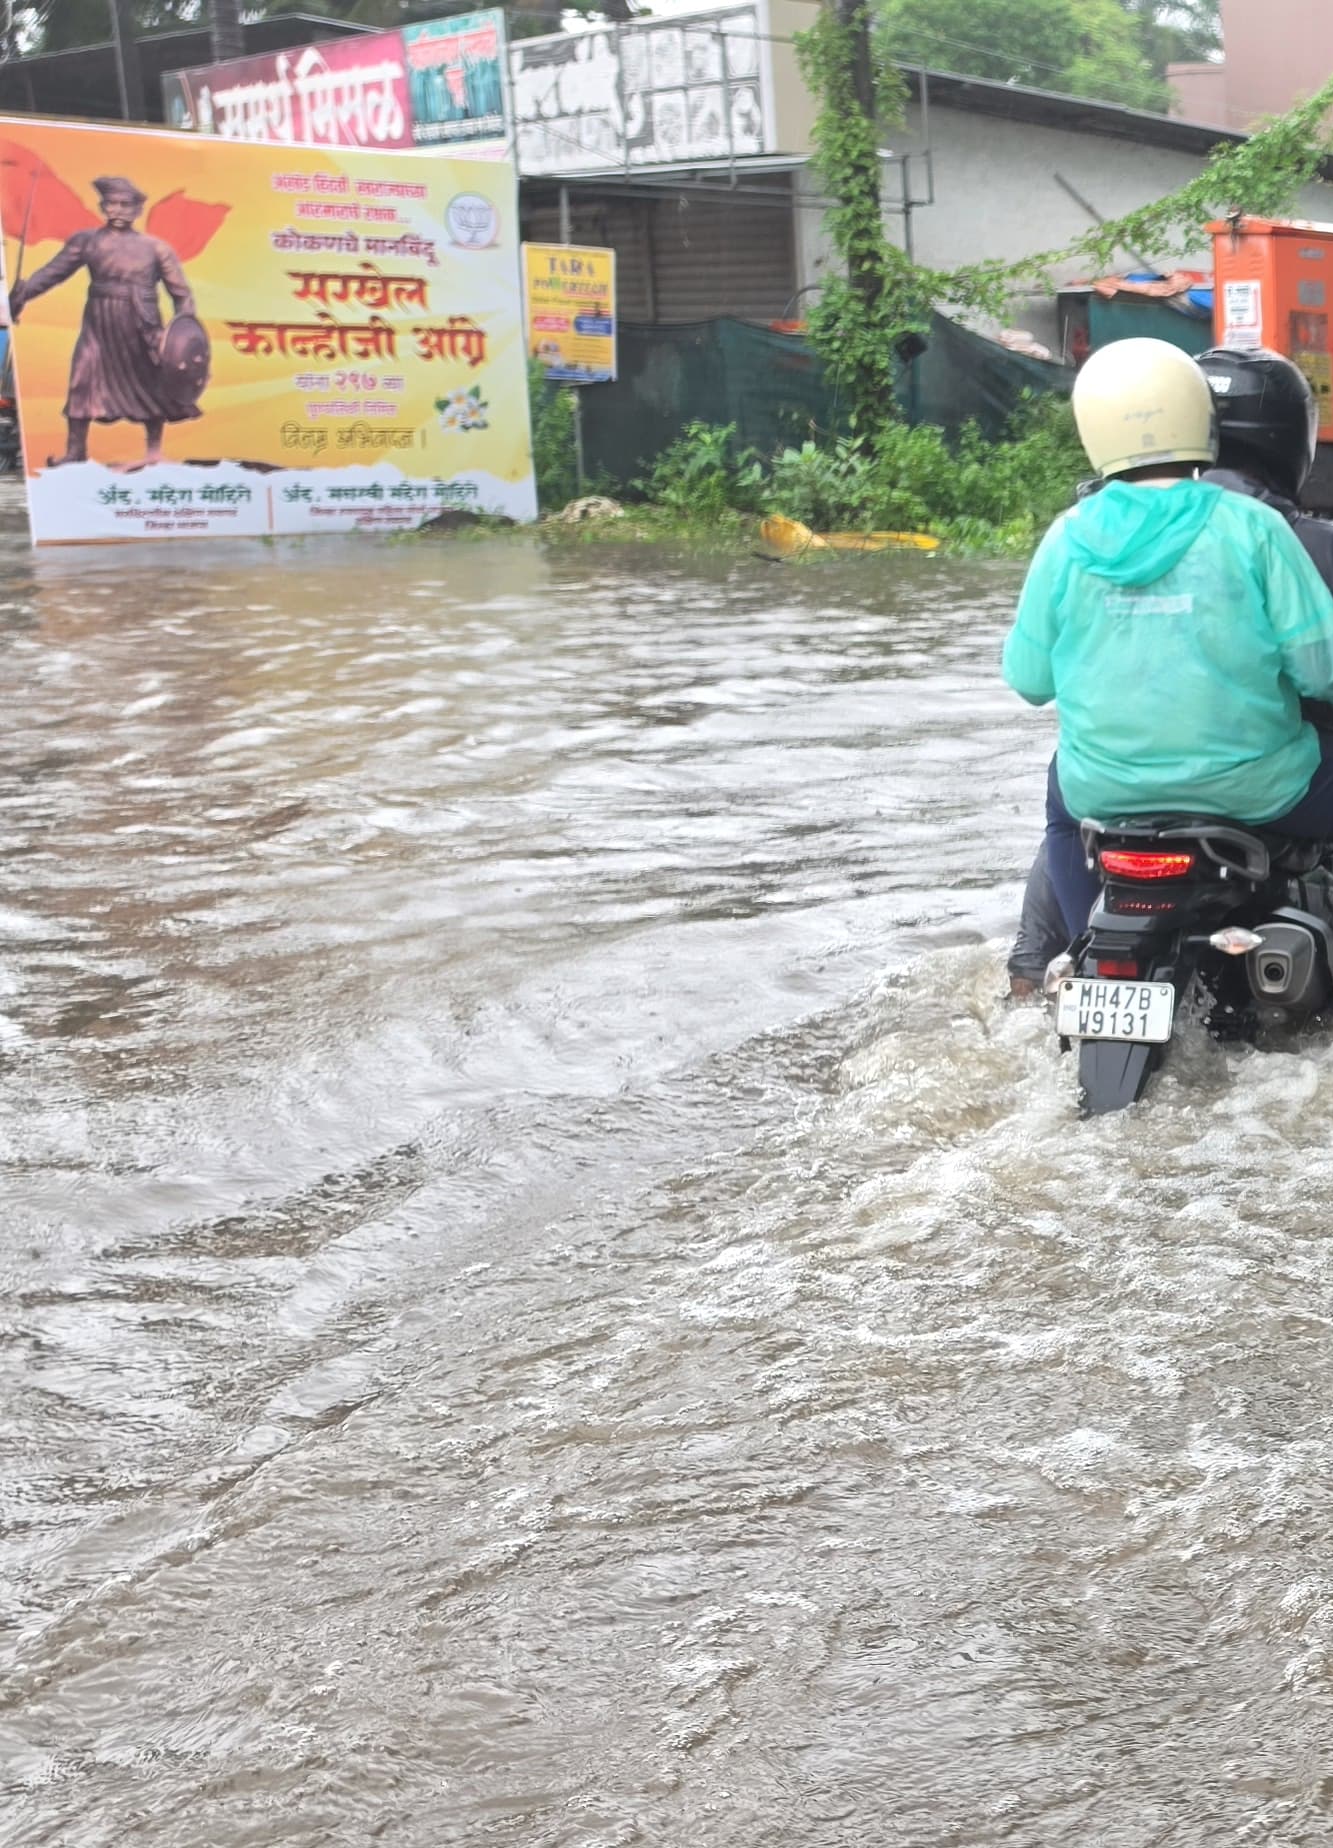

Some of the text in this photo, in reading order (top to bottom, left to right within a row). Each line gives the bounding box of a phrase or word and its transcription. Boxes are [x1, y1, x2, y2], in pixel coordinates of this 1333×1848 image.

[272, 228, 360, 253] कोकणचे
[287, 261, 429, 309] सरखेल
[225, 311, 397, 359] कान्होजी
[1080, 984, 1151, 1010] MH47B
[1078, 1010, 1148, 1036] W9131
